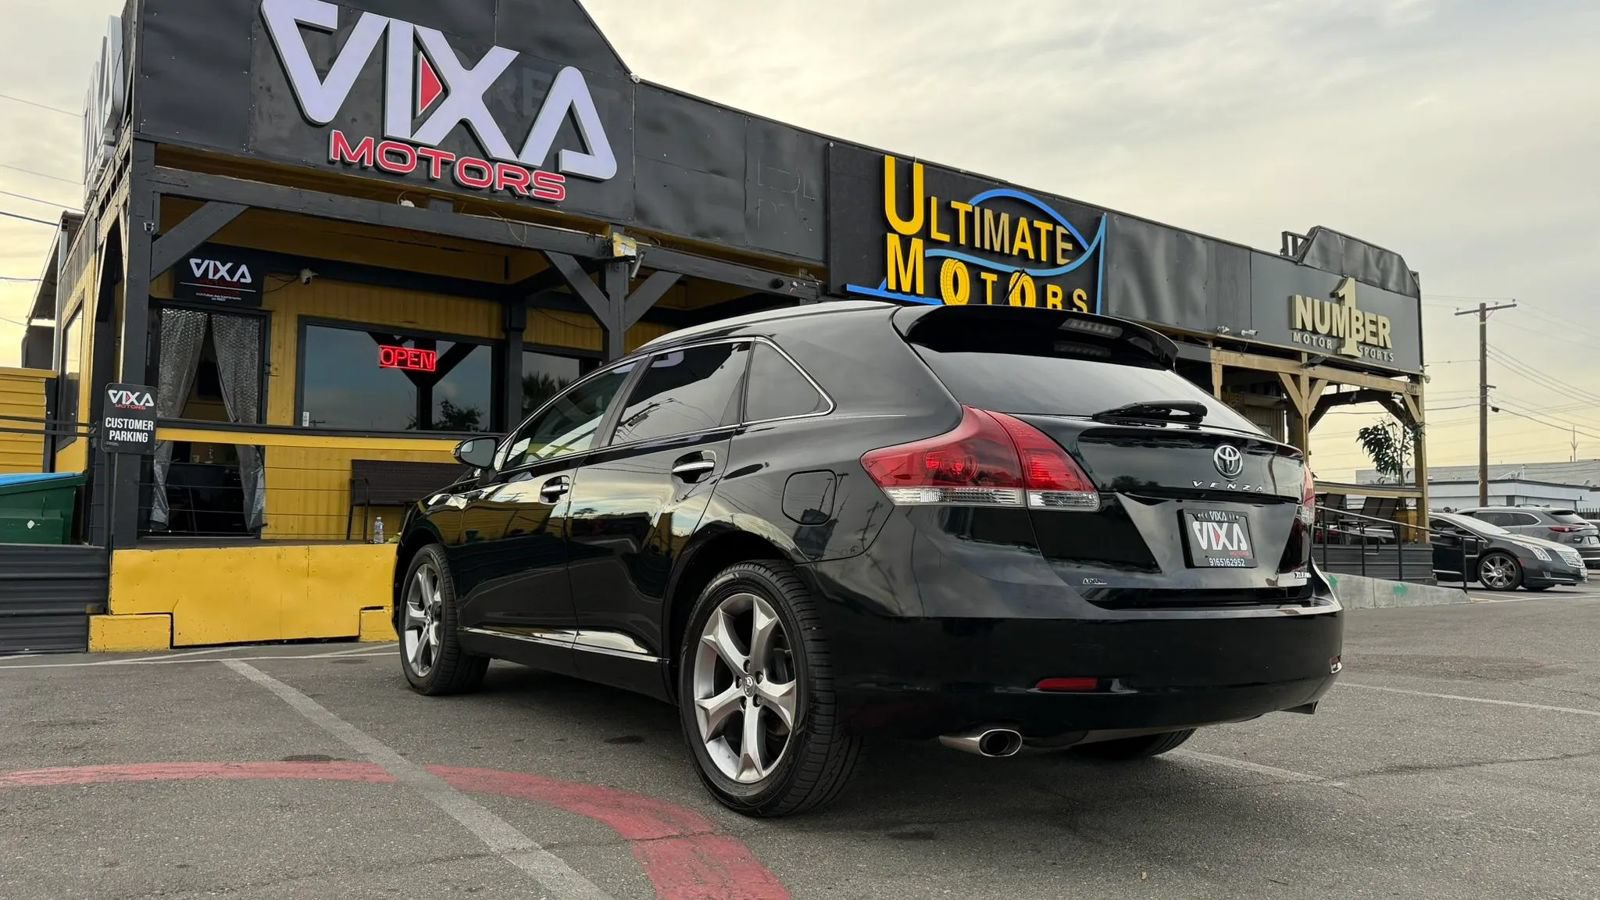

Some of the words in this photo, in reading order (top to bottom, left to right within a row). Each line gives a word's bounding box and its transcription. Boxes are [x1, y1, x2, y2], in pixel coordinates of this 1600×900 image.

[261, 0, 617, 180] VIXA
[329, 129, 567, 202] MOTORS
[884, 155, 1074, 265] ULTIMATE
[189, 258, 252, 283] VIXA
[887, 232, 1089, 314] MOTORS
[1292, 294, 1392, 349] NUMBER
[380, 348, 434, 369] OPEN
[1293, 332, 1333, 350] MOTOR
[1358, 345, 1394, 363] SPORTS
[108, 389, 154, 406] VIXA
[105, 417, 154, 431] CUSTOMER
[109, 430, 149, 442] PARKING
[1192, 480, 1264, 493] VENZA
[1193, 521, 1248, 550] VIXA
[1209, 558, 1246, 567] 9165162952
